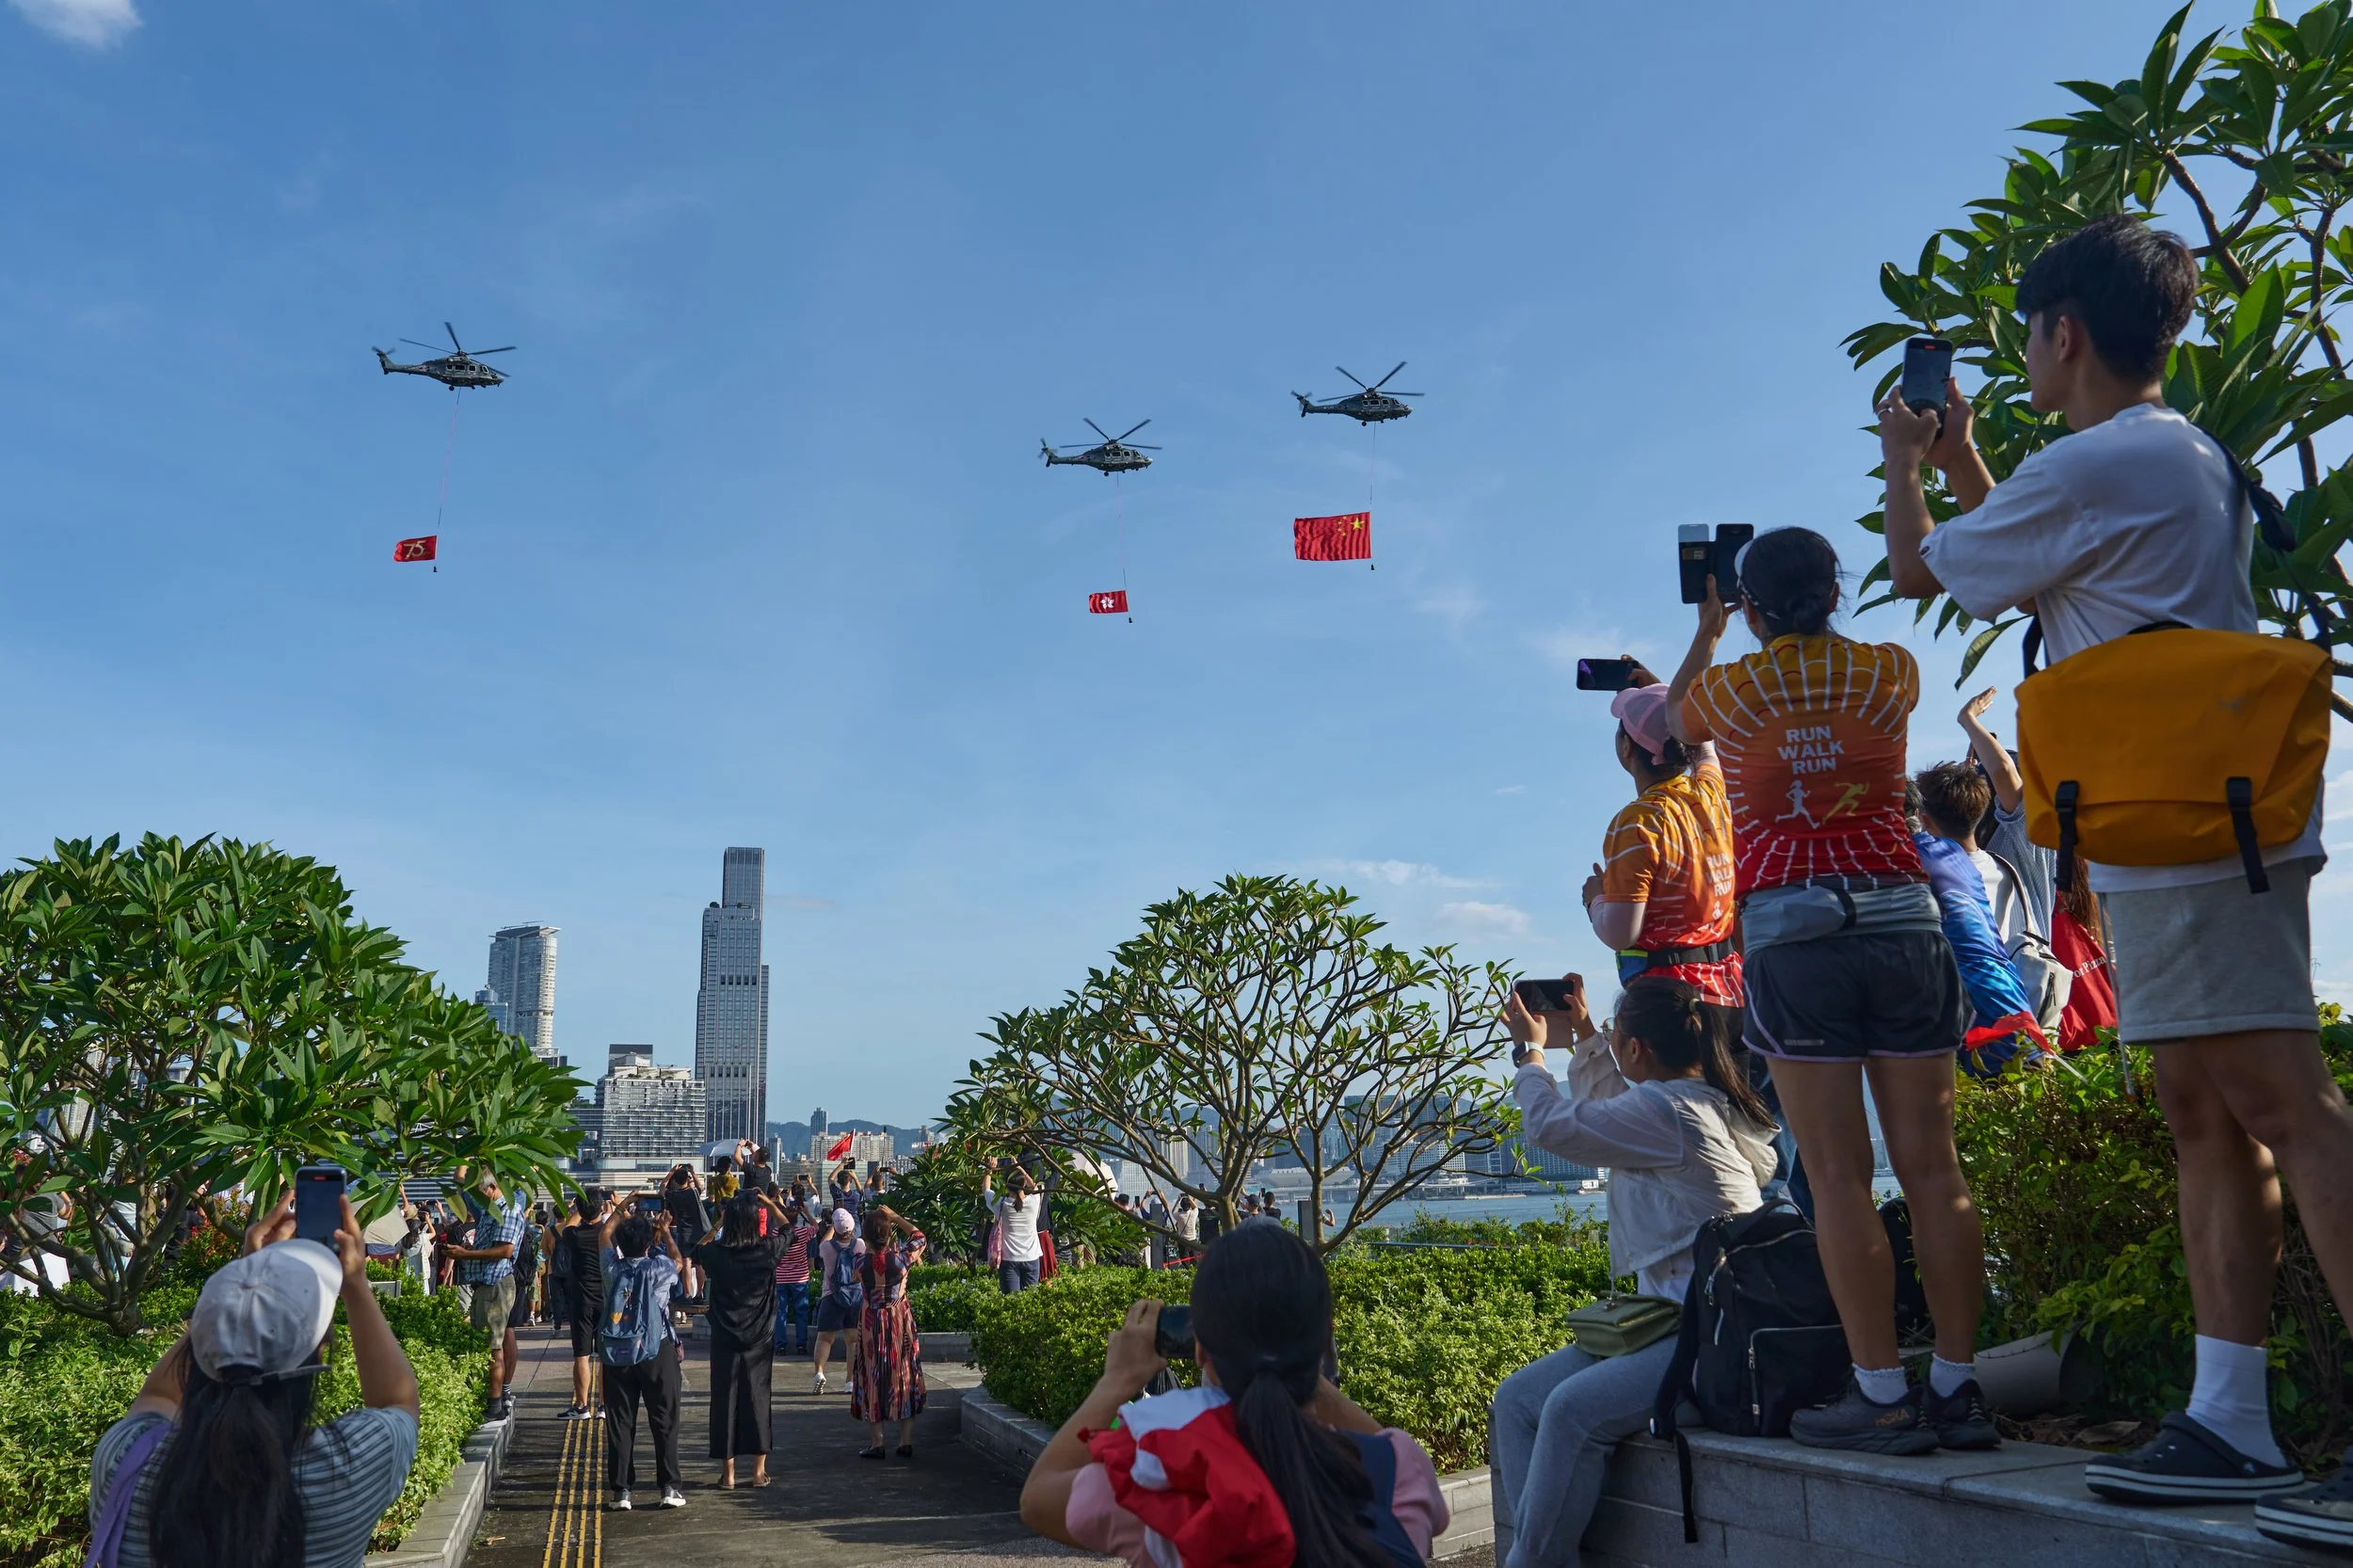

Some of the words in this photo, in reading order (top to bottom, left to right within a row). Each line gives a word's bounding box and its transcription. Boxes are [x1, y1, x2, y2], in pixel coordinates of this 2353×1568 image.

[403, 540, 426, 560] 75
[1785, 725, 1832, 743] RUN
[1777, 740, 1845, 760] WALK
[1792, 758, 1836, 775] RUN
[1705, 853, 1731, 869] RUN
[1714, 880, 1733, 897] RUN
[2073, 967, 2085, 978] or
